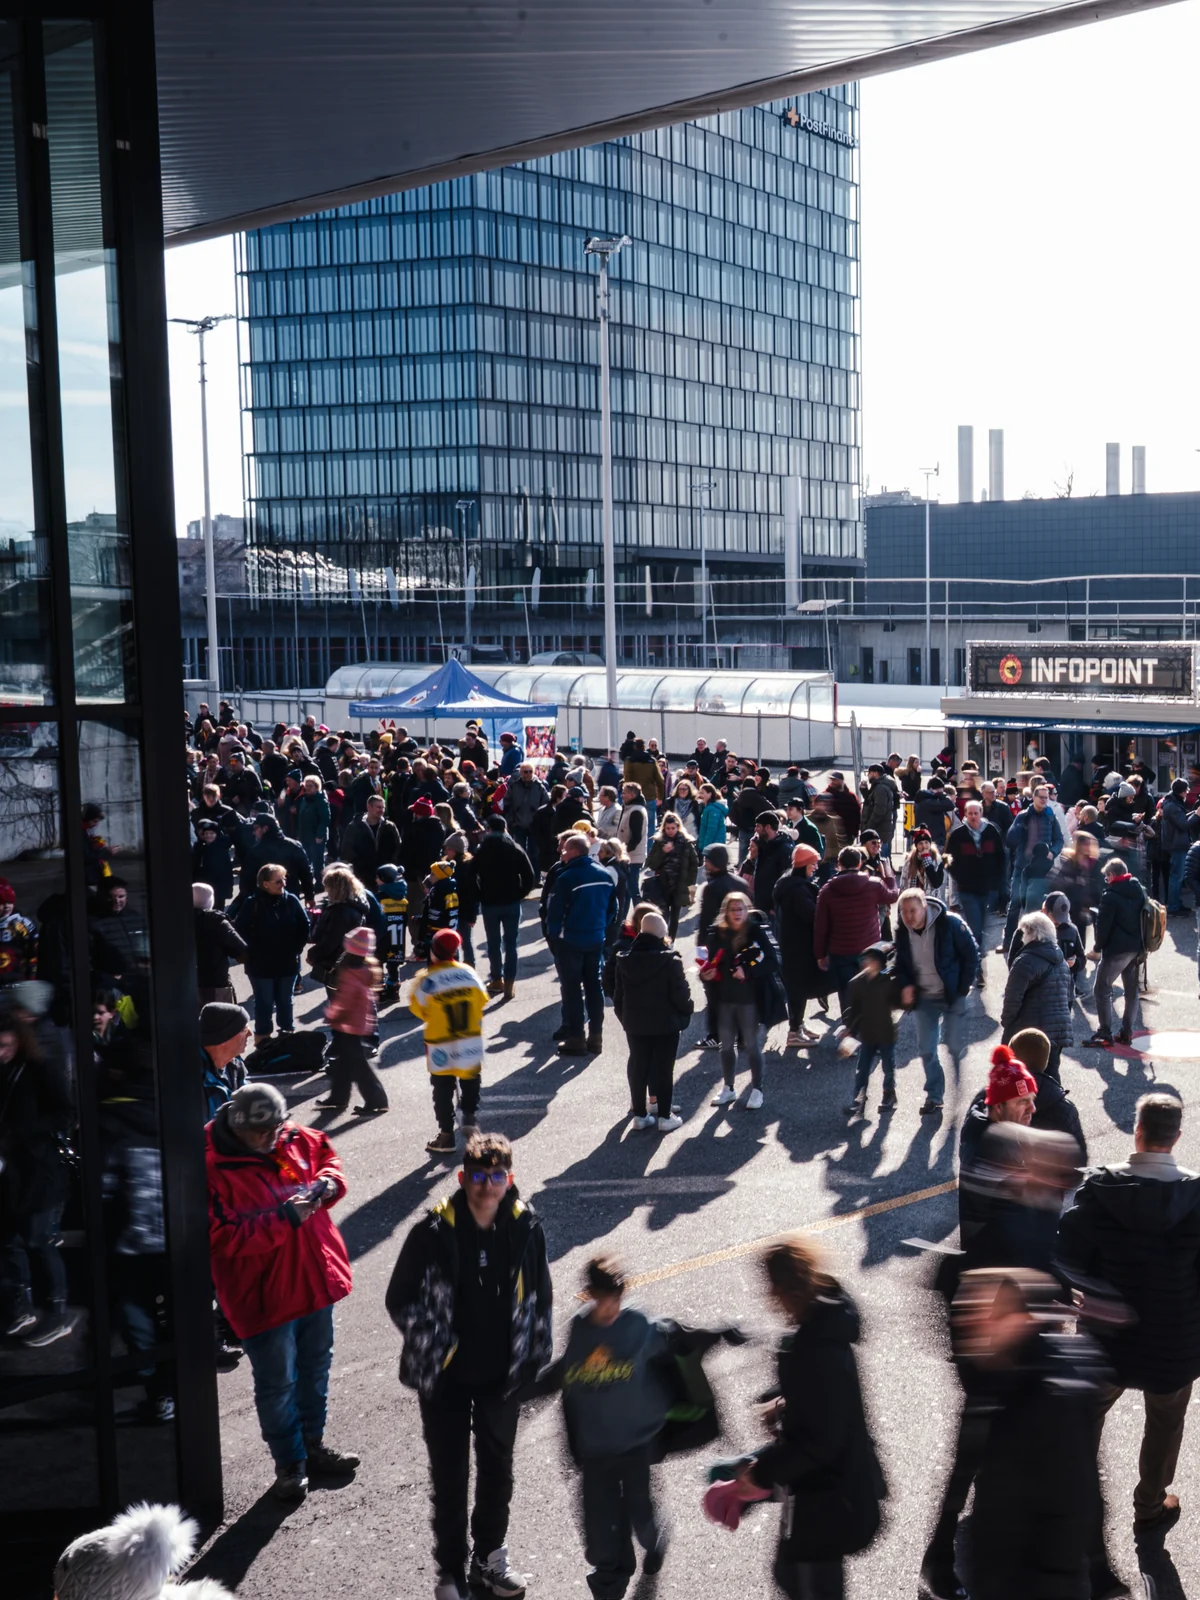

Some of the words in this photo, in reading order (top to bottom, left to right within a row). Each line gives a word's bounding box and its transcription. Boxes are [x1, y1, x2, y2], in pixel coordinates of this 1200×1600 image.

[800, 113, 859, 148] PostFinance
[1031, 656, 1159, 685] INFOPOINT
[387, 924, 404, 946] 11
